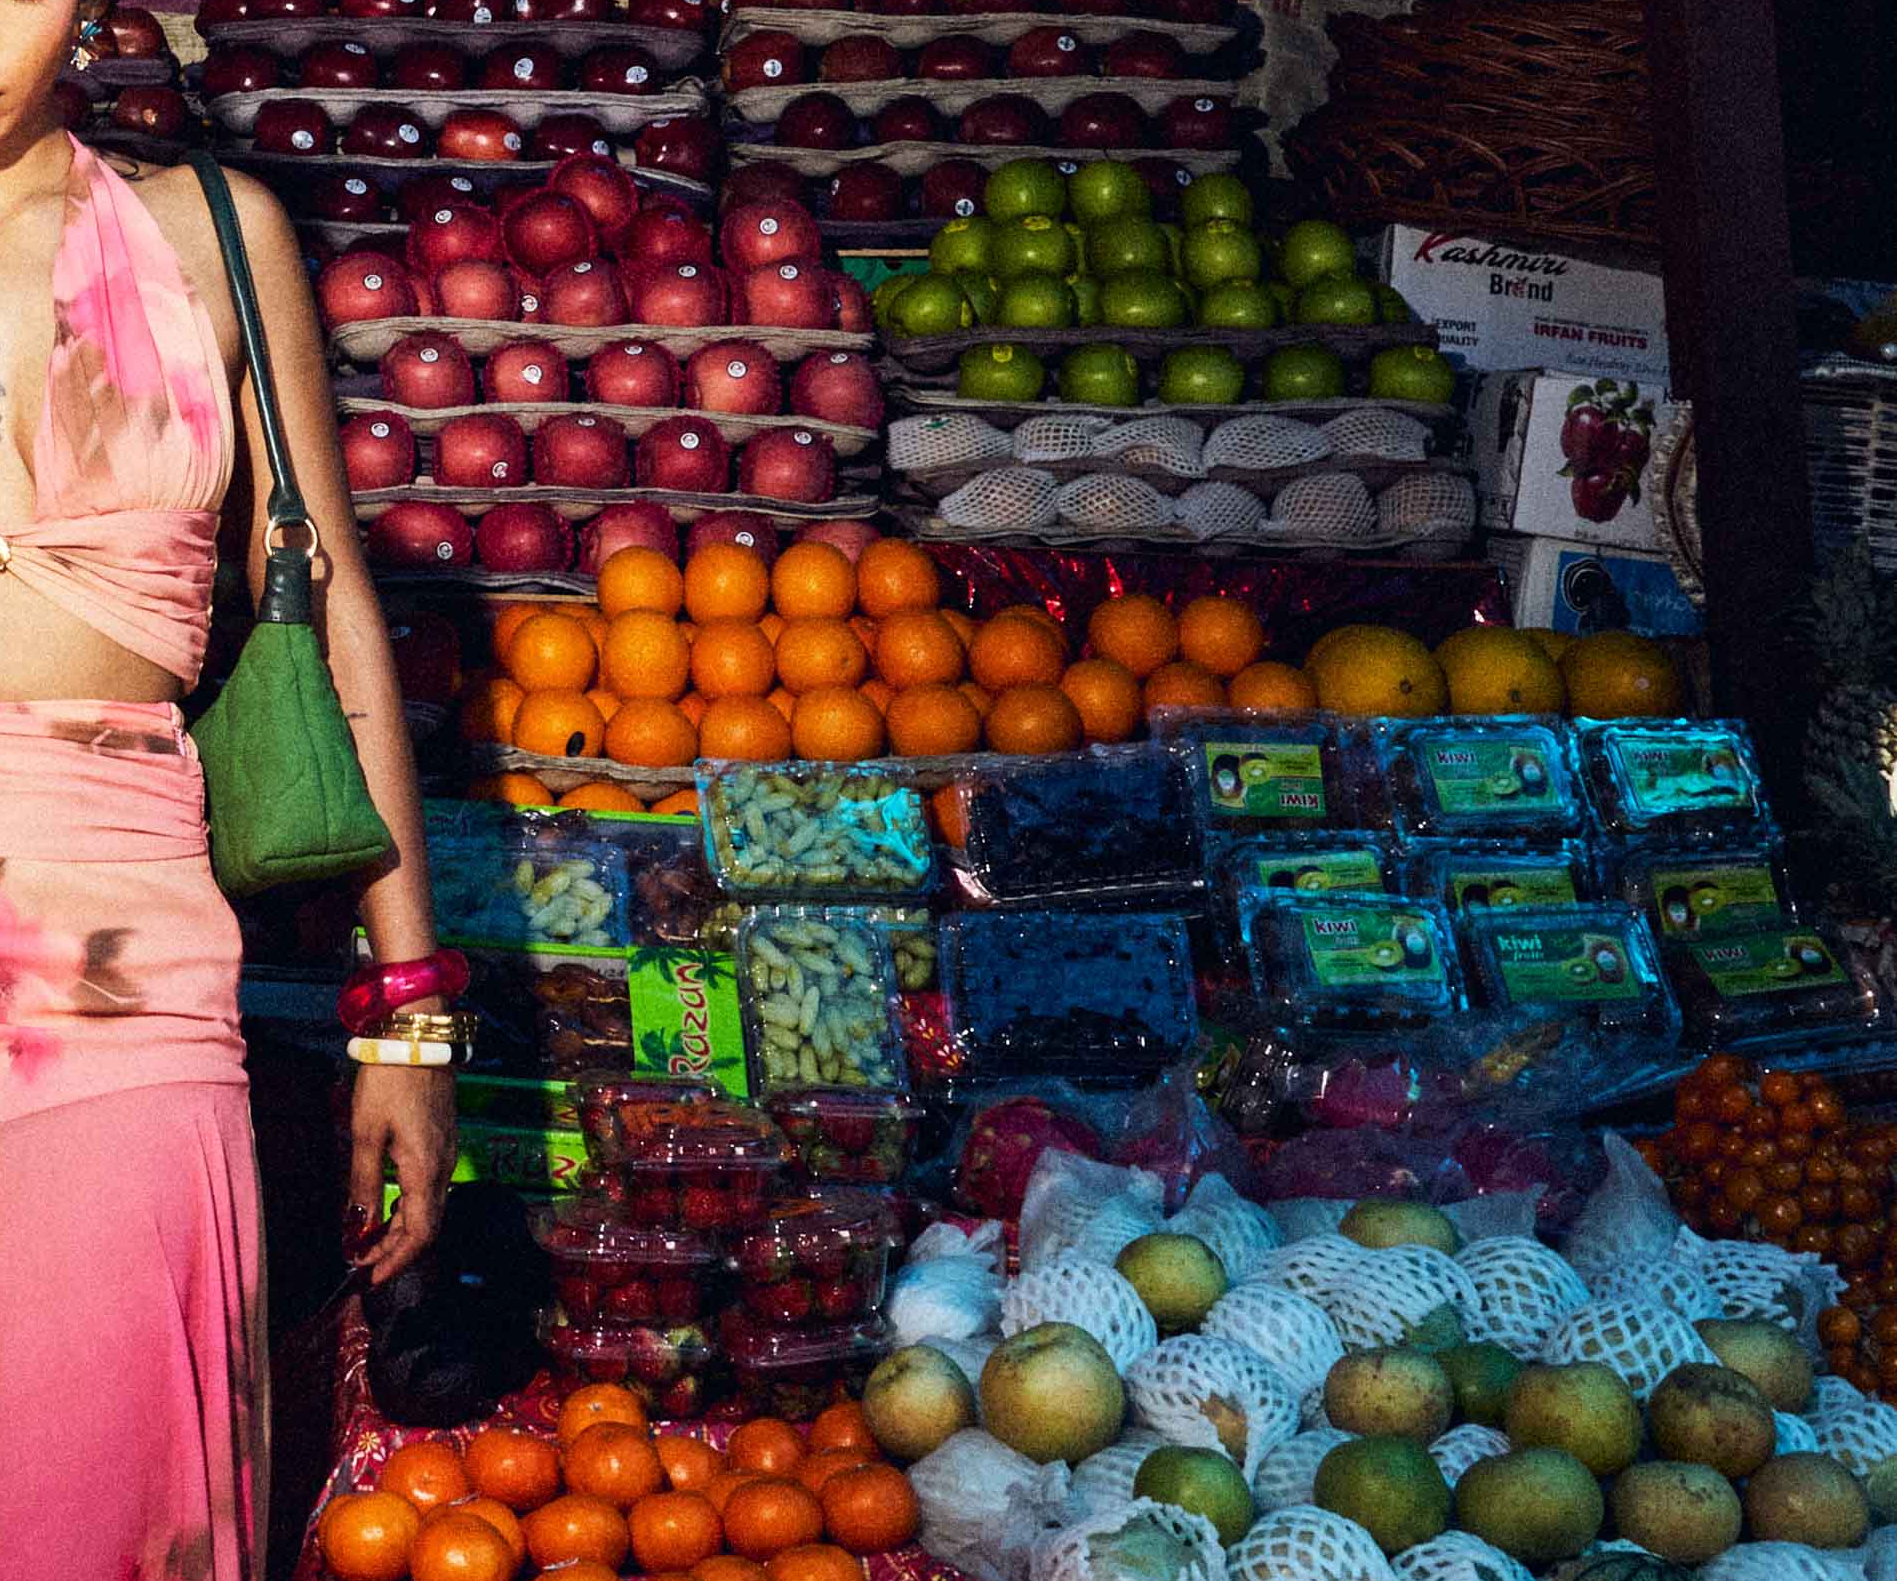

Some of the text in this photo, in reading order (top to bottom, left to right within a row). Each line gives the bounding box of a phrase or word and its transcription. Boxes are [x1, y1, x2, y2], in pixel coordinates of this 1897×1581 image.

[1414, 230, 1567, 276] Kashmiri
[1534, 323, 1584, 342] IRFAN
[1588, 329, 1648, 350] FRUITS
[670, 962, 710, 1078] Razan
